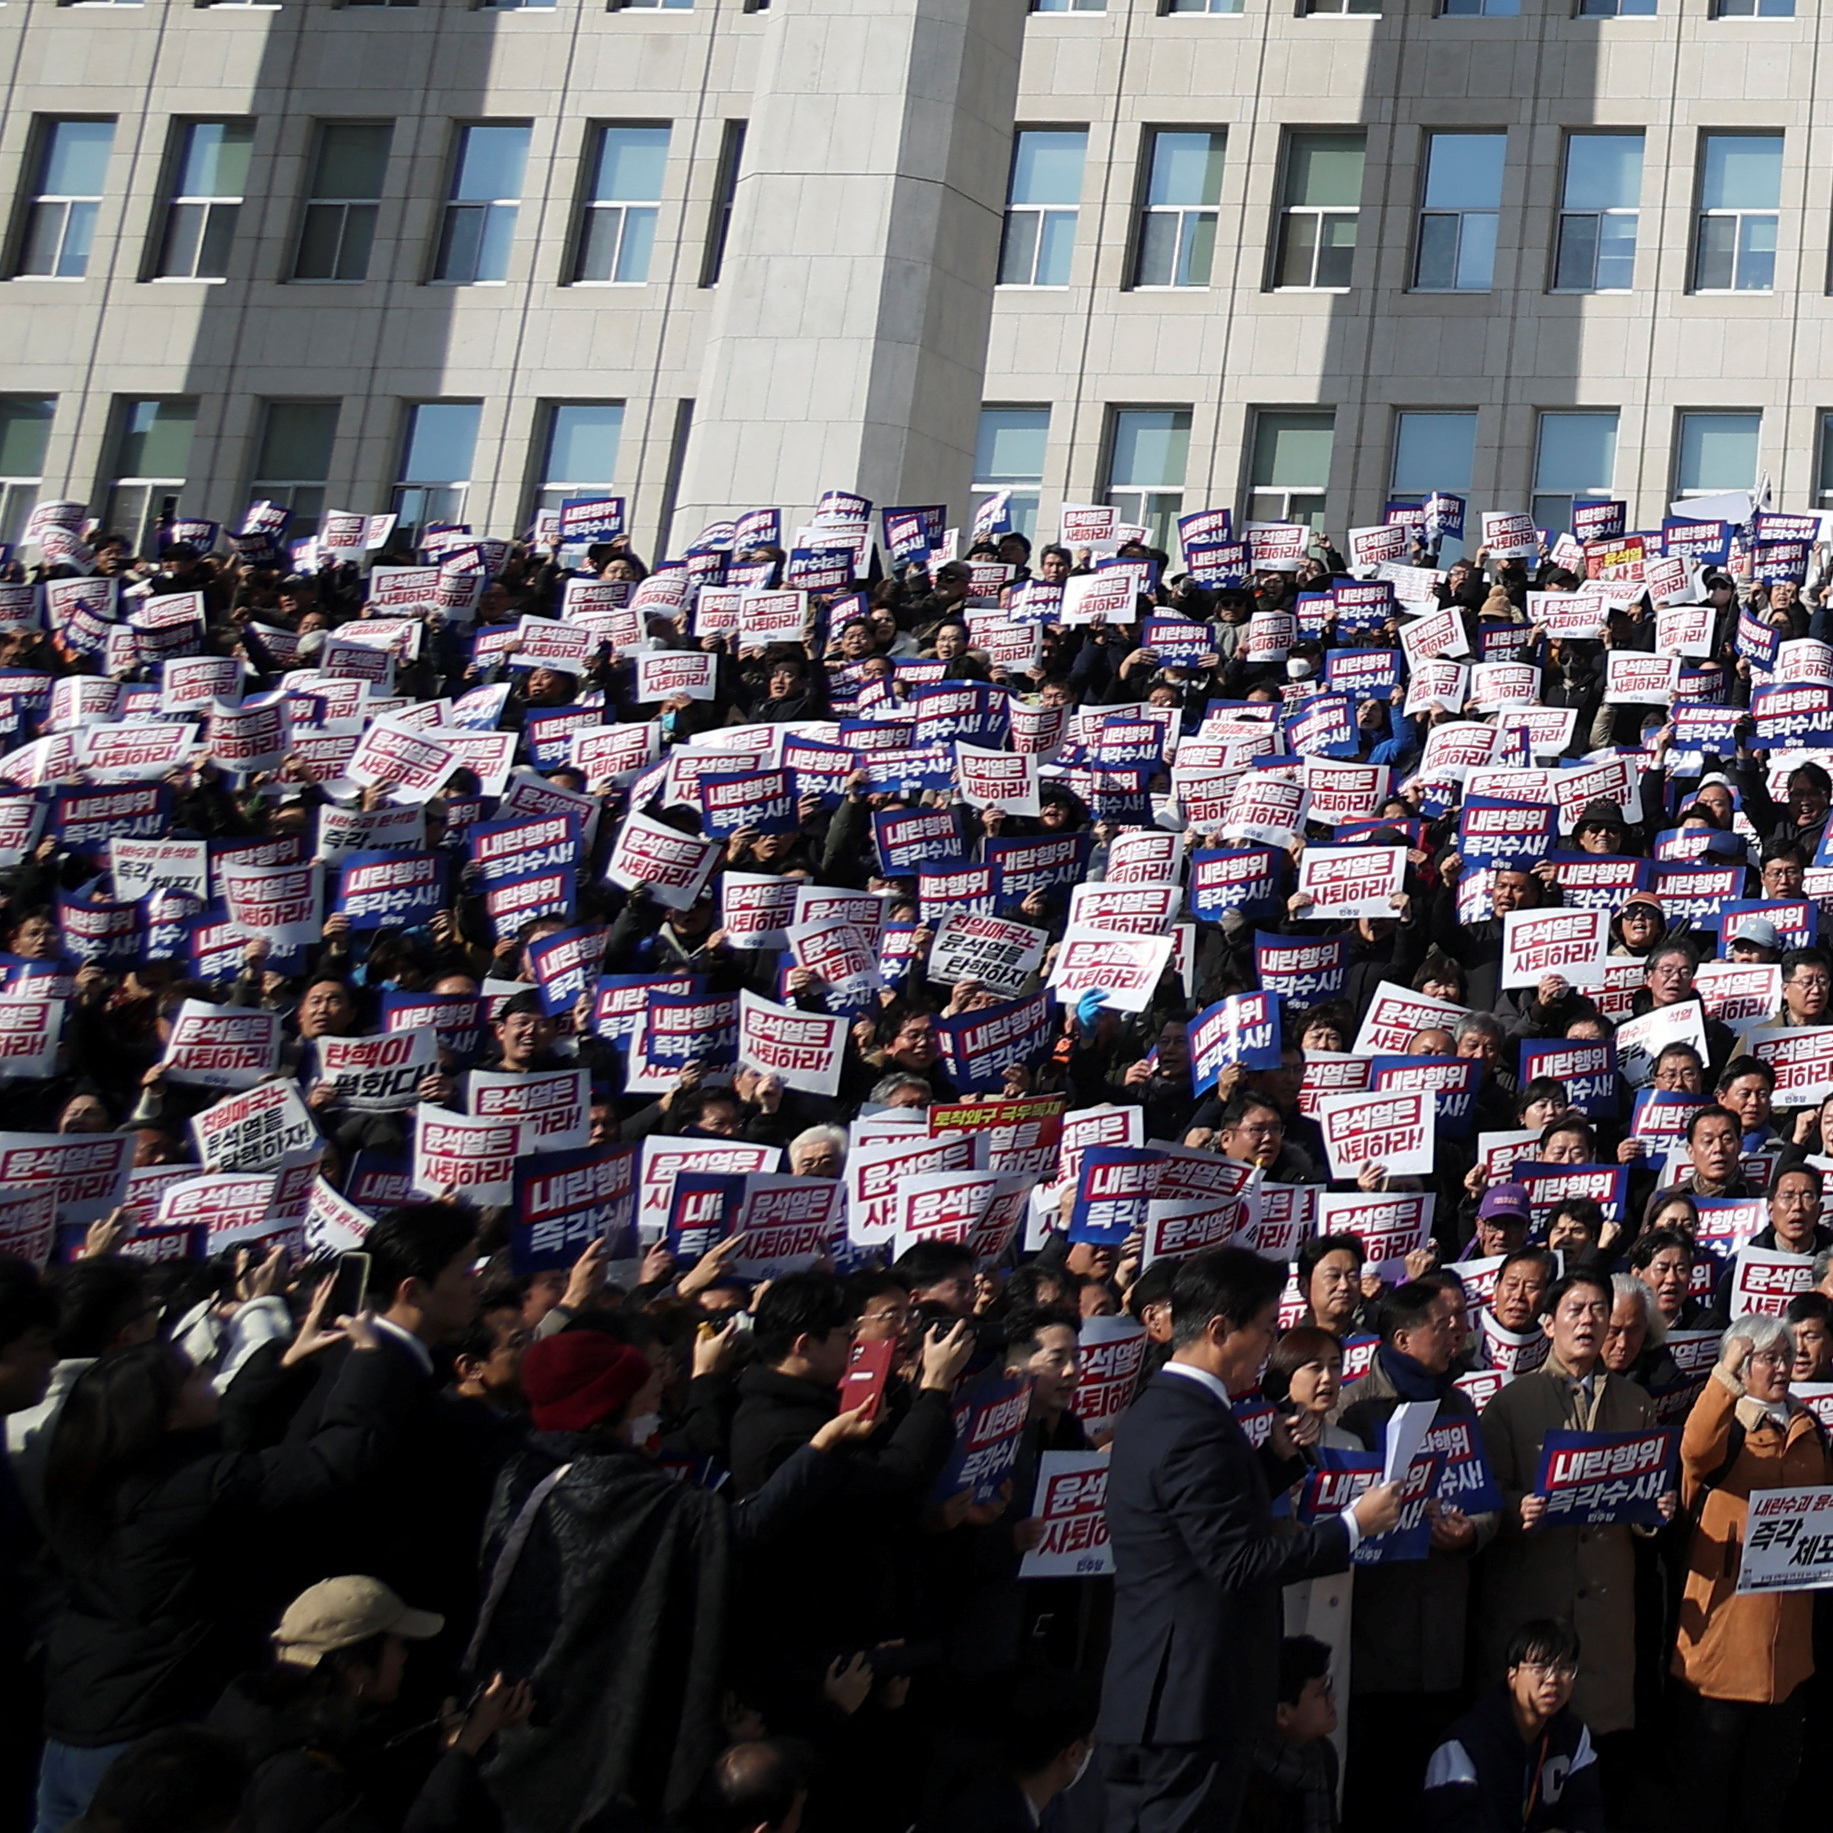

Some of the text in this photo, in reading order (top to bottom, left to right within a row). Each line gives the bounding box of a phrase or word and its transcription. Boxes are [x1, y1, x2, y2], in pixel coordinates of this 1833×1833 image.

[1605, 546, 1642, 567] 윤석열
[1753, 689, 1832, 719] 내란행위
[1756, 711, 1833, 738] 즉각수사!
[95, 732, 191, 754] 윤석열은
[962, 754, 1030, 782] 윤석열은
[66, 788, 159, 819] 내란행위
[481, 826, 569, 857] 내란행위
[348, 860, 435, 893] 내란행위
[482, 848, 575, 877] 즉각수사!
[1197, 854, 1269, 887] 내란행위
[346, 884, 439, 918] 즉각수사!
[1198, 877, 1273, 910] 즉각수사!
[945, 915, 1040, 949] 친일매국노
[1512, 919, 1595, 953] 윤석열은
[939, 934, 1025, 964] 윤석열을
[1512, 943, 1599, 975] 사퇴하라!
[746, 1008, 835, 1047] 윤석열은
[326, 1035, 415, 1068] 탄핵이
[747, 1037, 830, 1073] 사퇴하라!
[203, 1087, 289, 1135] 친일매국노
[934, 1106, 997, 1127] 토착왜구
[1327, 1098, 1420, 1139] 윤석열은
[207, 1107, 284, 1158] 윤석열을
[427, 1126, 513, 1154] 윤석열은
[1337, 1127, 1425, 1163] 사퇴하라!
[1555, 1436, 1669, 1485] 내란행위
[1546, 1471, 1666, 1513] 즉각수사!
[1754, 1495, 1813, 1516] 내란수괴
[1749, 1518, 1804, 1550] 즉각
